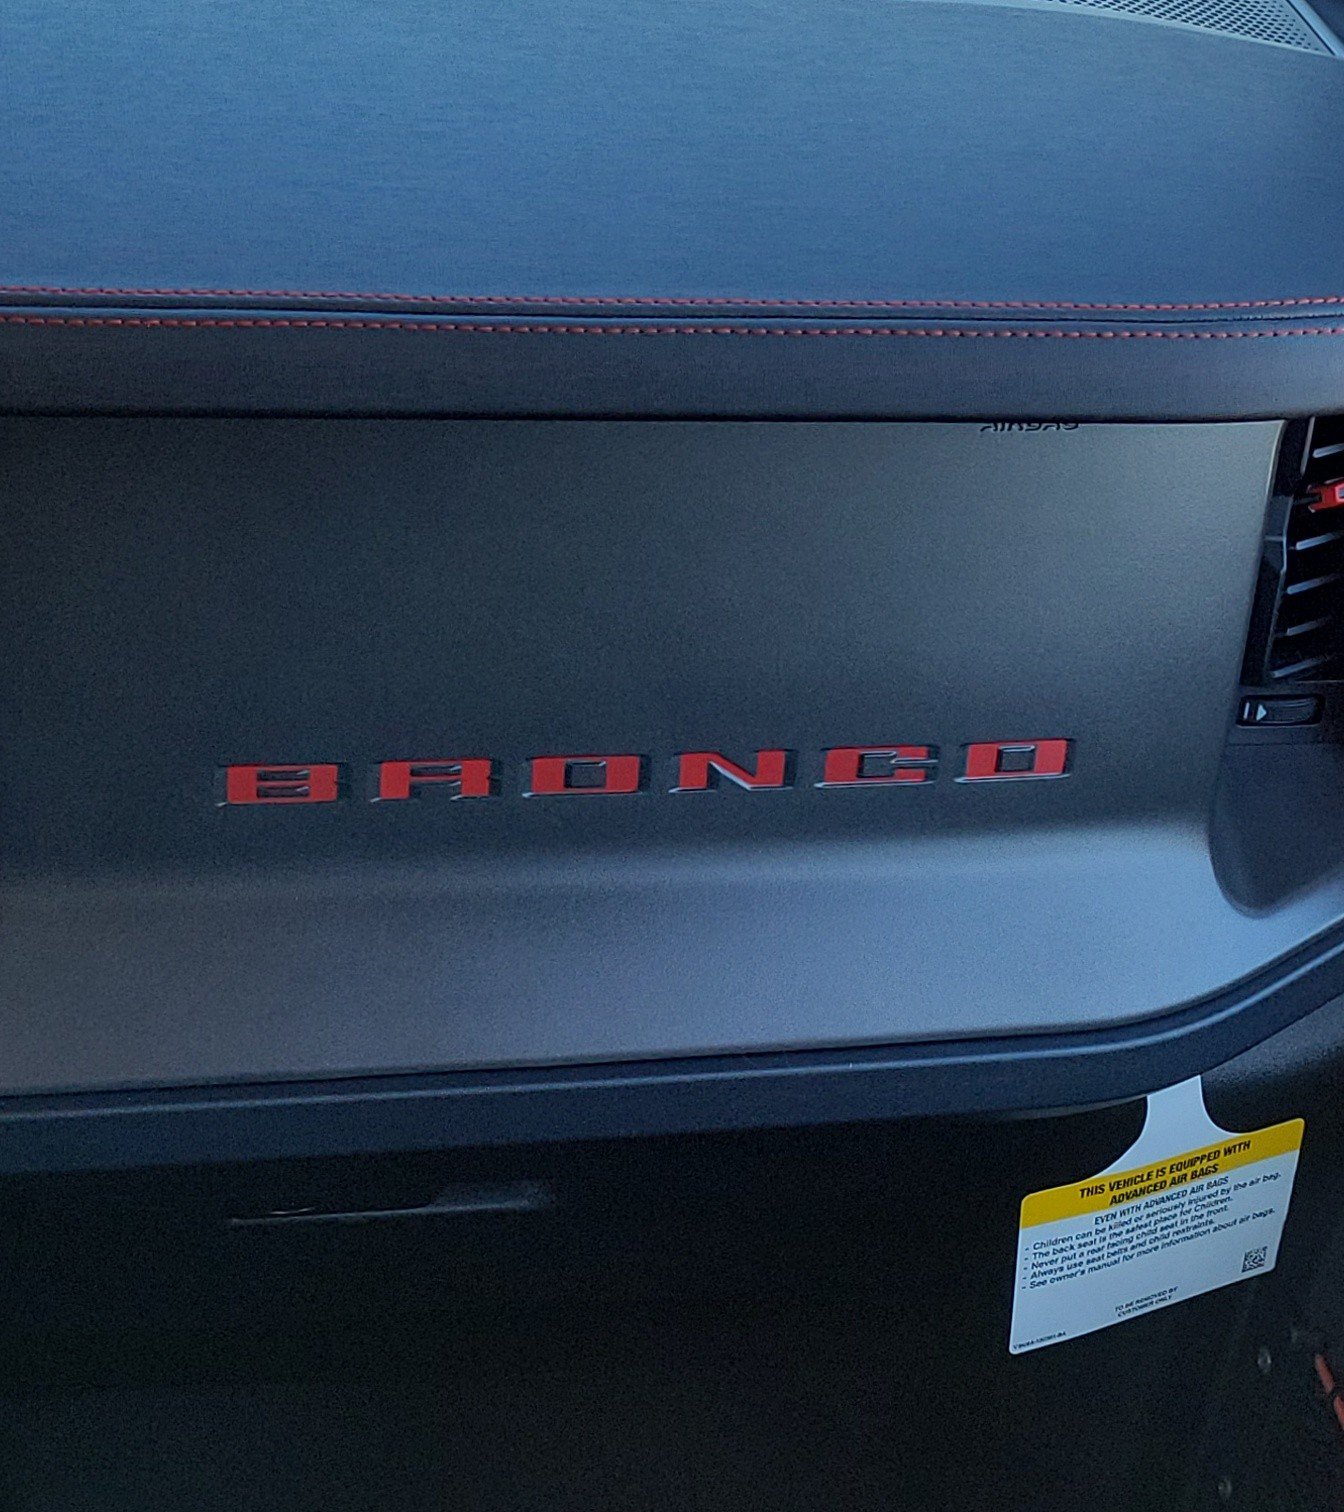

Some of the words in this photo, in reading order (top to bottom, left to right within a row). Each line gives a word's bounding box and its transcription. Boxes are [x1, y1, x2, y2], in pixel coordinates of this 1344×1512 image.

[220, 736, 1072, 807] BRONCO
[1080, 1184, 1105, 1198] THIS
[1108, 1170, 1154, 1191] VEHICLE
[1156, 1167, 1167, 1178] IS
[1169, 1150, 1220, 1174] EQUIPPED
[1223, 1140, 1251, 1157] WITH
[1109, 1179, 1167, 1206] ADVANCED
[1169, 1172, 1187, 1185] AIR
[1191, 1164, 1219, 1180] BAGS
[1094, 1212, 1117, 1225] EVEN
[1119, 1204, 1142, 1217] WITH
[1143, 1190, 1187, 1209] ADVANCED
[1189, 1184, 1204, 1195] AIR
[1206, 1176, 1229, 1190] BAGS
[1032, 1250, 1050, 1260] The
[1052, 1244, 1075, 1256] back
[1077, 1238, 1097, 1250] seat
[1033, 1235, 1073, 1250] Children
[1076, 1231, 1092, 1240] can
[1095, 1227, 1106, 1235] be
[1029, 1279, 1047, 1289] See
[1049, 1269, 1085, 1284] owner's
[1088, 1257, 1121, 1274] manual
[1030, 1264, 1064, 1280] Always
[1066, 1260, 1083, 1271] use
[1031, 1258, 1059, 1270] Never
[1061, 1252, 1076, 1264] put
[1086, 1245, 1105, 1256] rear
